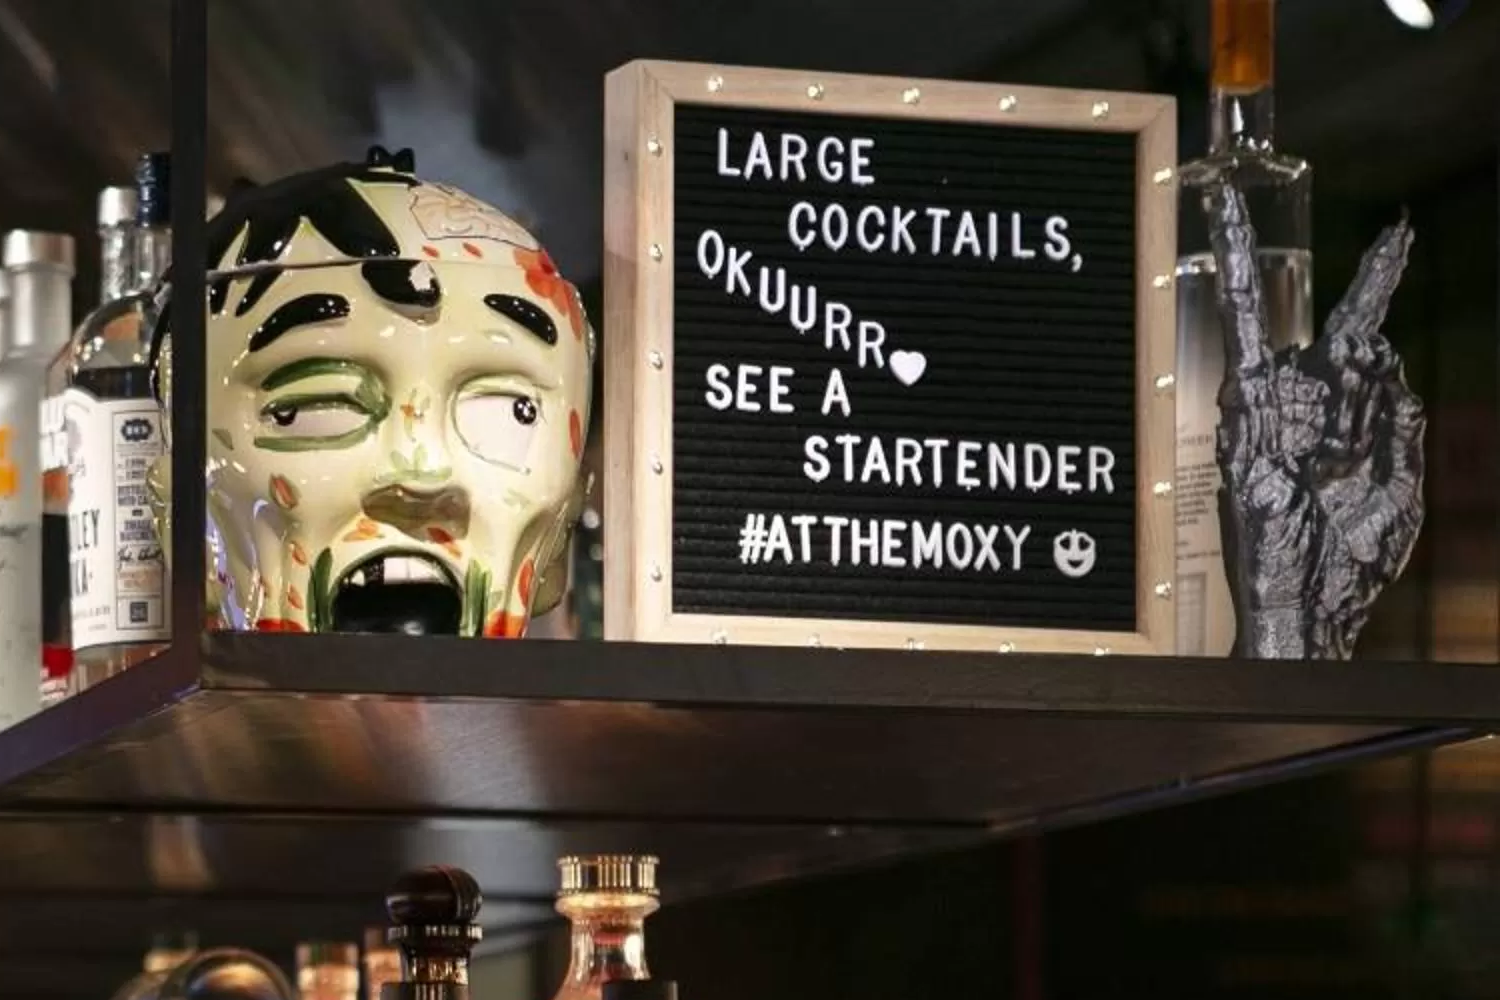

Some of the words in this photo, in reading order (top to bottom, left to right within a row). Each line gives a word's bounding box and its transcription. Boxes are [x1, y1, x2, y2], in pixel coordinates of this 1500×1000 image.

[717, 127, 875, 186] LARGE
[787, 201, 1084, 273] COCKTAILS,
[696, 229, 887, 370] OKUURR
[704, 363, 796, 413] SEE
[820, 367, 851, 417] A
[802, 433, 1116, 495] STARTENDER
[737, 512, 1032, 571] #ATTHEMOXY
